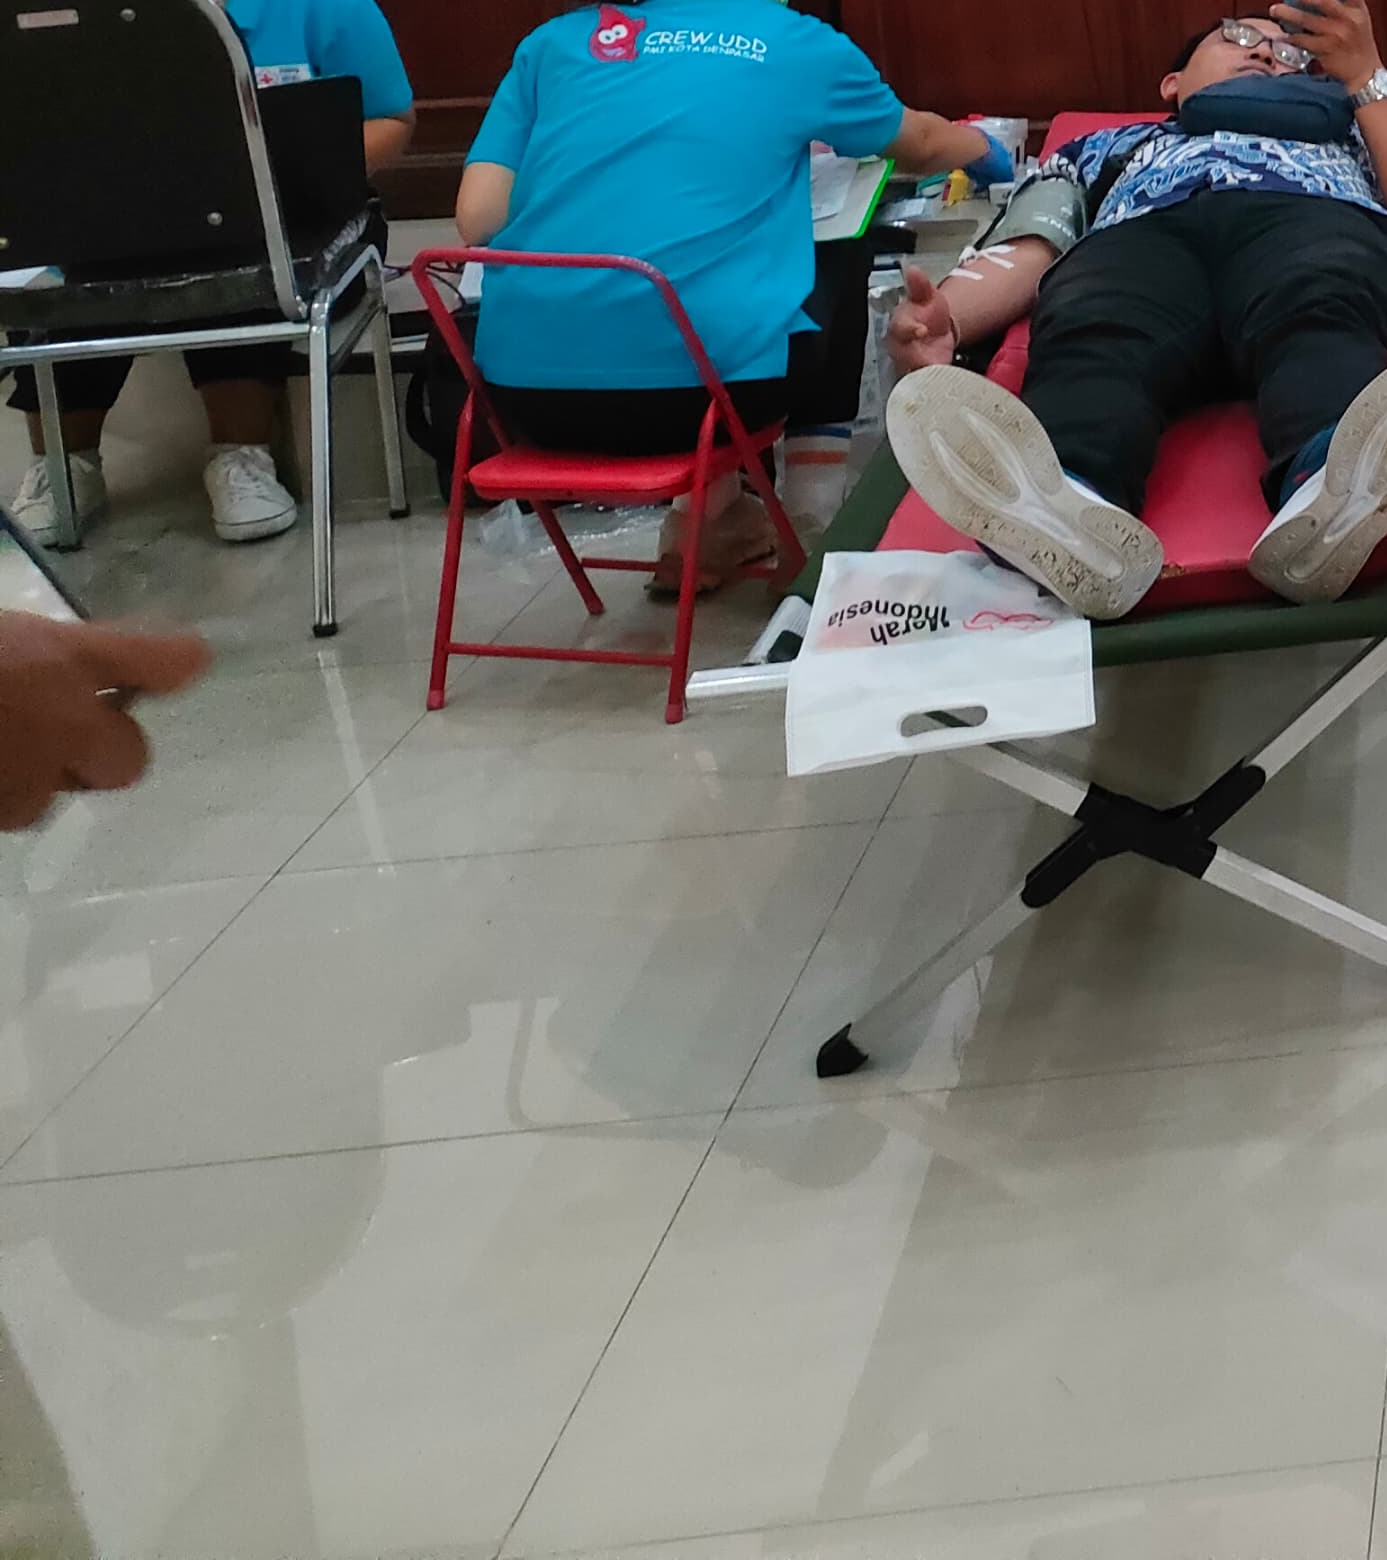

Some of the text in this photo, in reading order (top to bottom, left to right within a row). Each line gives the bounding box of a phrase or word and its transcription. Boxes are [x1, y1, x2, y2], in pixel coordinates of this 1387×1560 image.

[644, 30, 767, 54] CREW UDD
[828, 599, 948, 628] Indonesia
[871, 618, 950, 645] Merah
